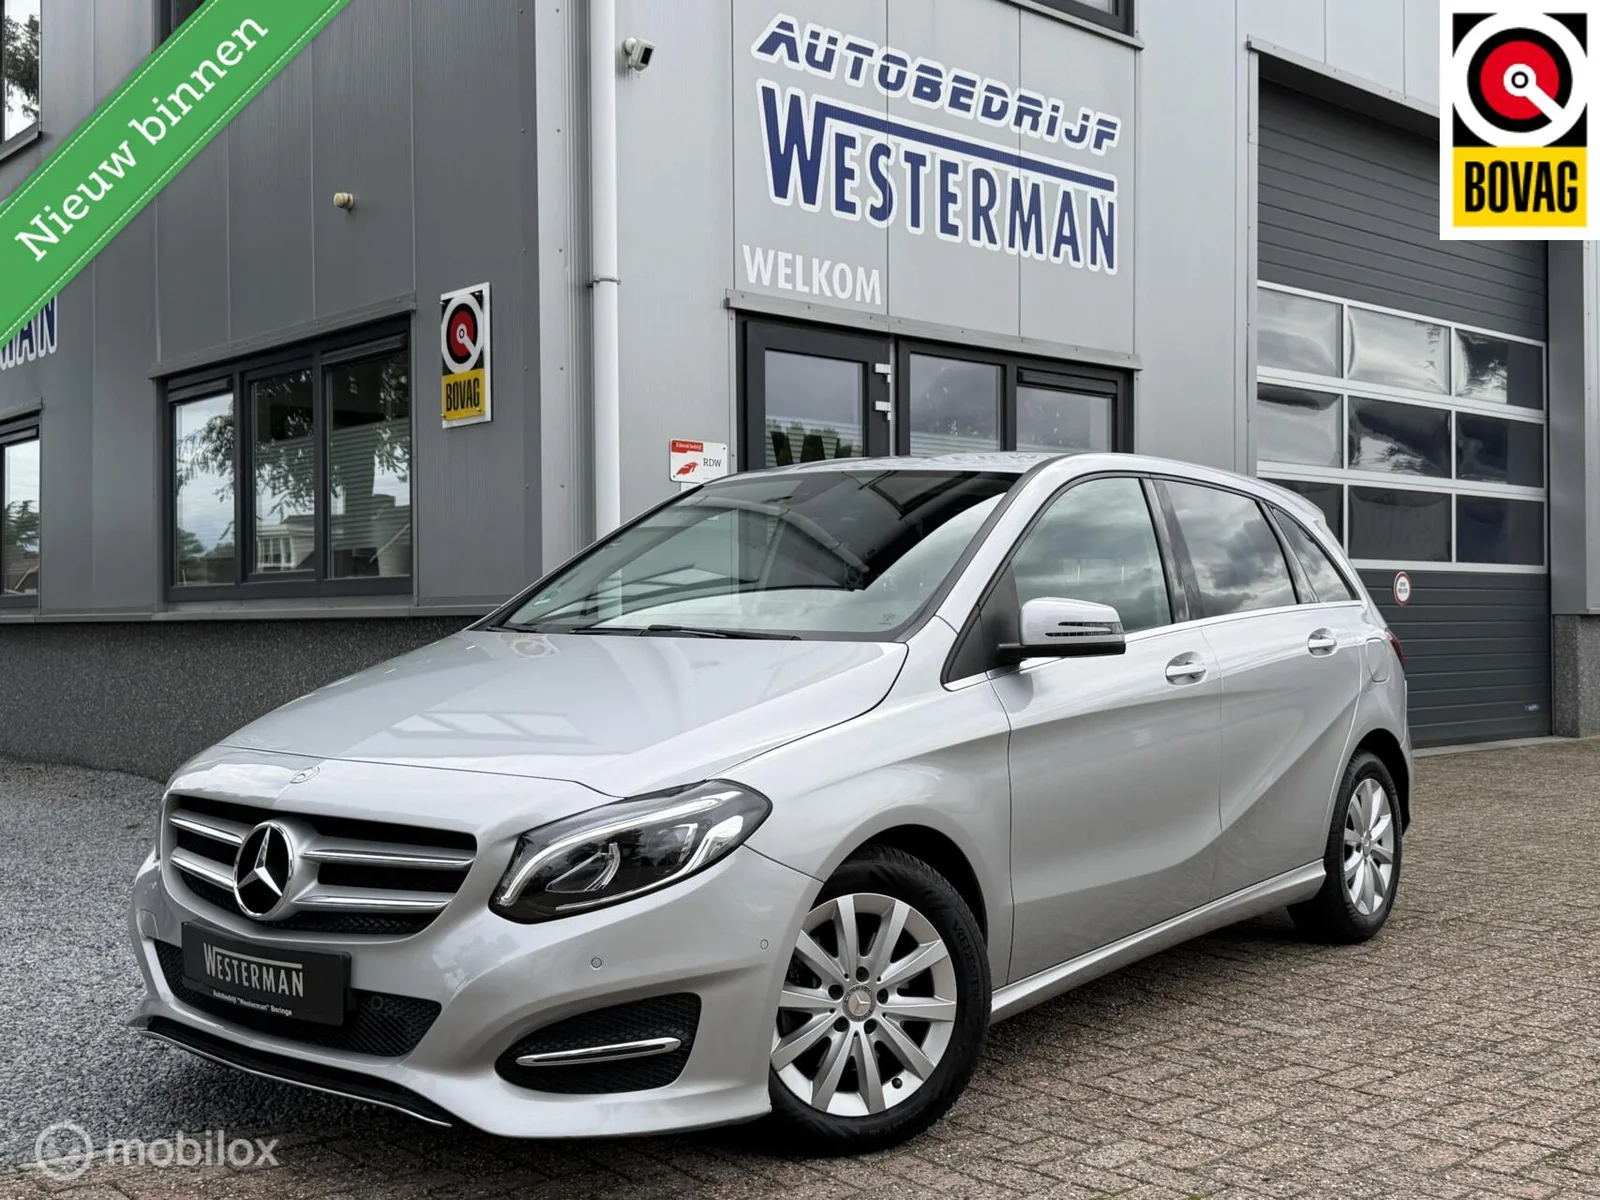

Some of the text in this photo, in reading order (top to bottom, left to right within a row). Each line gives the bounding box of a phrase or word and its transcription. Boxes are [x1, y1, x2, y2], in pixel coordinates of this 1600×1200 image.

[758, 80, 1118, 275] WESTERMAN
[742, 244, 882, 306] WELKOM
[445, 376, 481, 412] BOVAG
[703, 458, 721, 467] RDW
[203, 942, 304, 998] WESTERMAN
